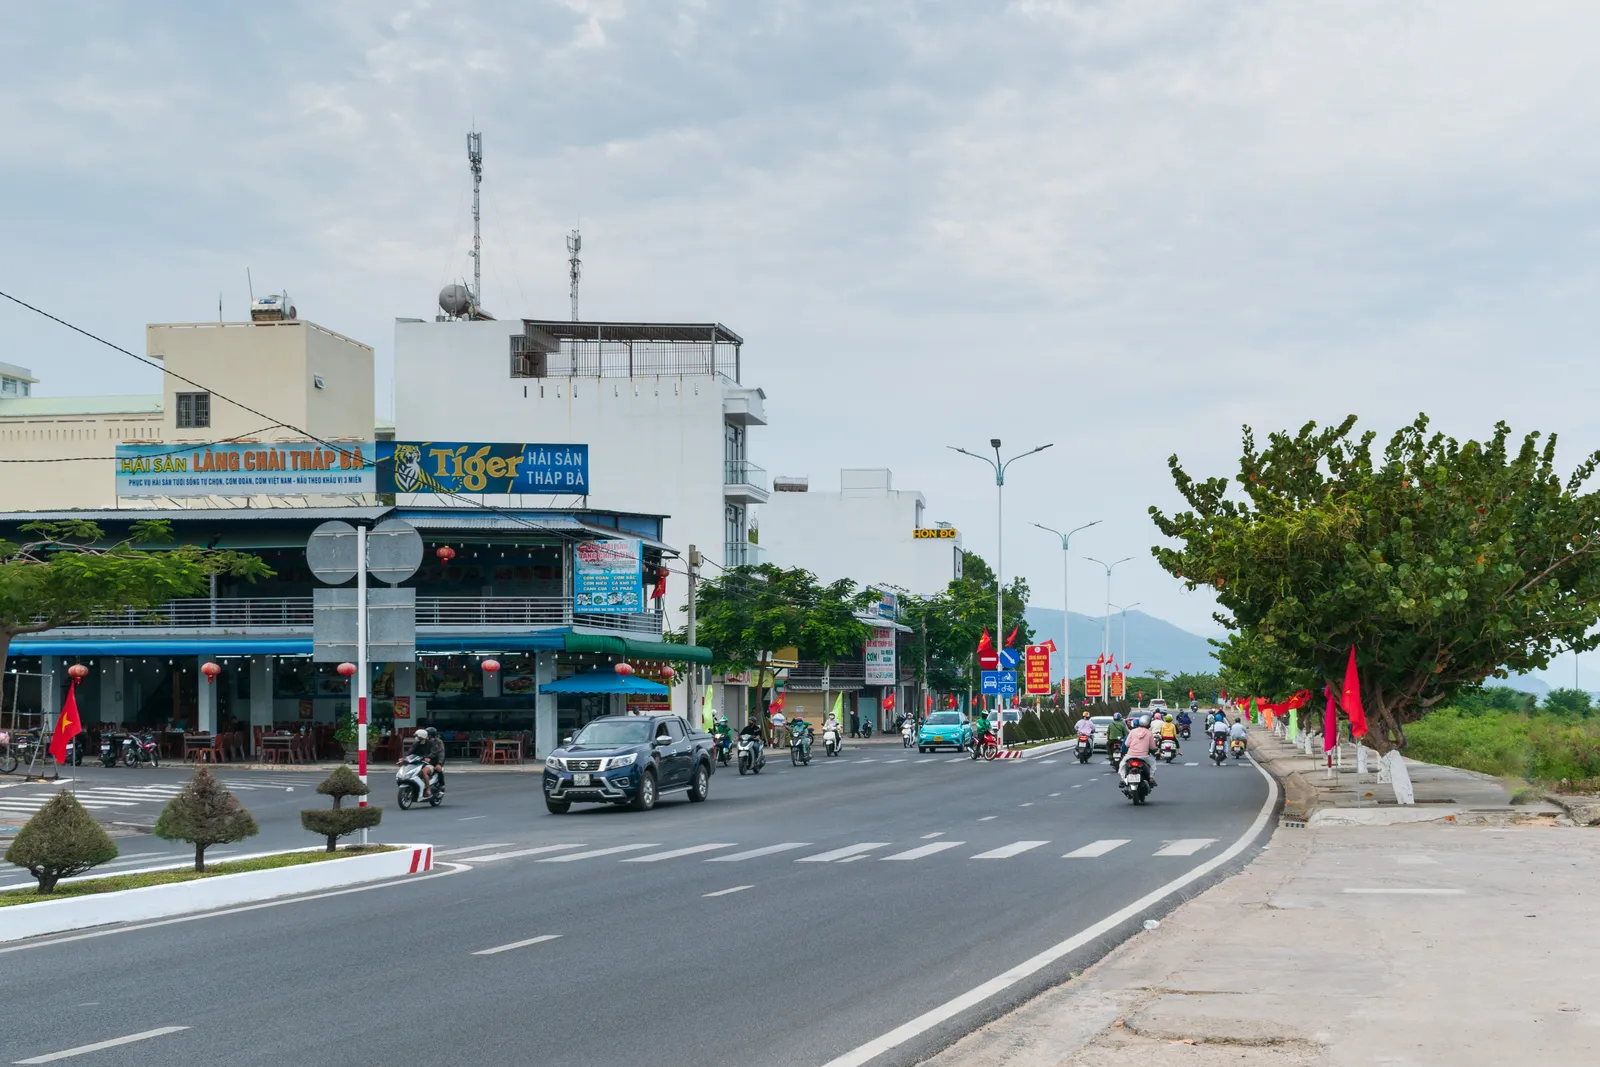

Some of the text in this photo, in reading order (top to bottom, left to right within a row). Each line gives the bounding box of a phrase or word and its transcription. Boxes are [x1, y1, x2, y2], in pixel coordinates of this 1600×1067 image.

[121, 445, 365, 473] HẢI SẢN LÀNG CHÀI THÁP BÀ
[528, 447, 582, 466] HẢI SẢN
[429, 445, 524, 491] Tiger
[526, 468, 585, 486] THÁP BÀ
[280, 477, 292, 485] NAM
[308, 476, 321, 484] THEO
[913, 527, 937, 539] HÒN
